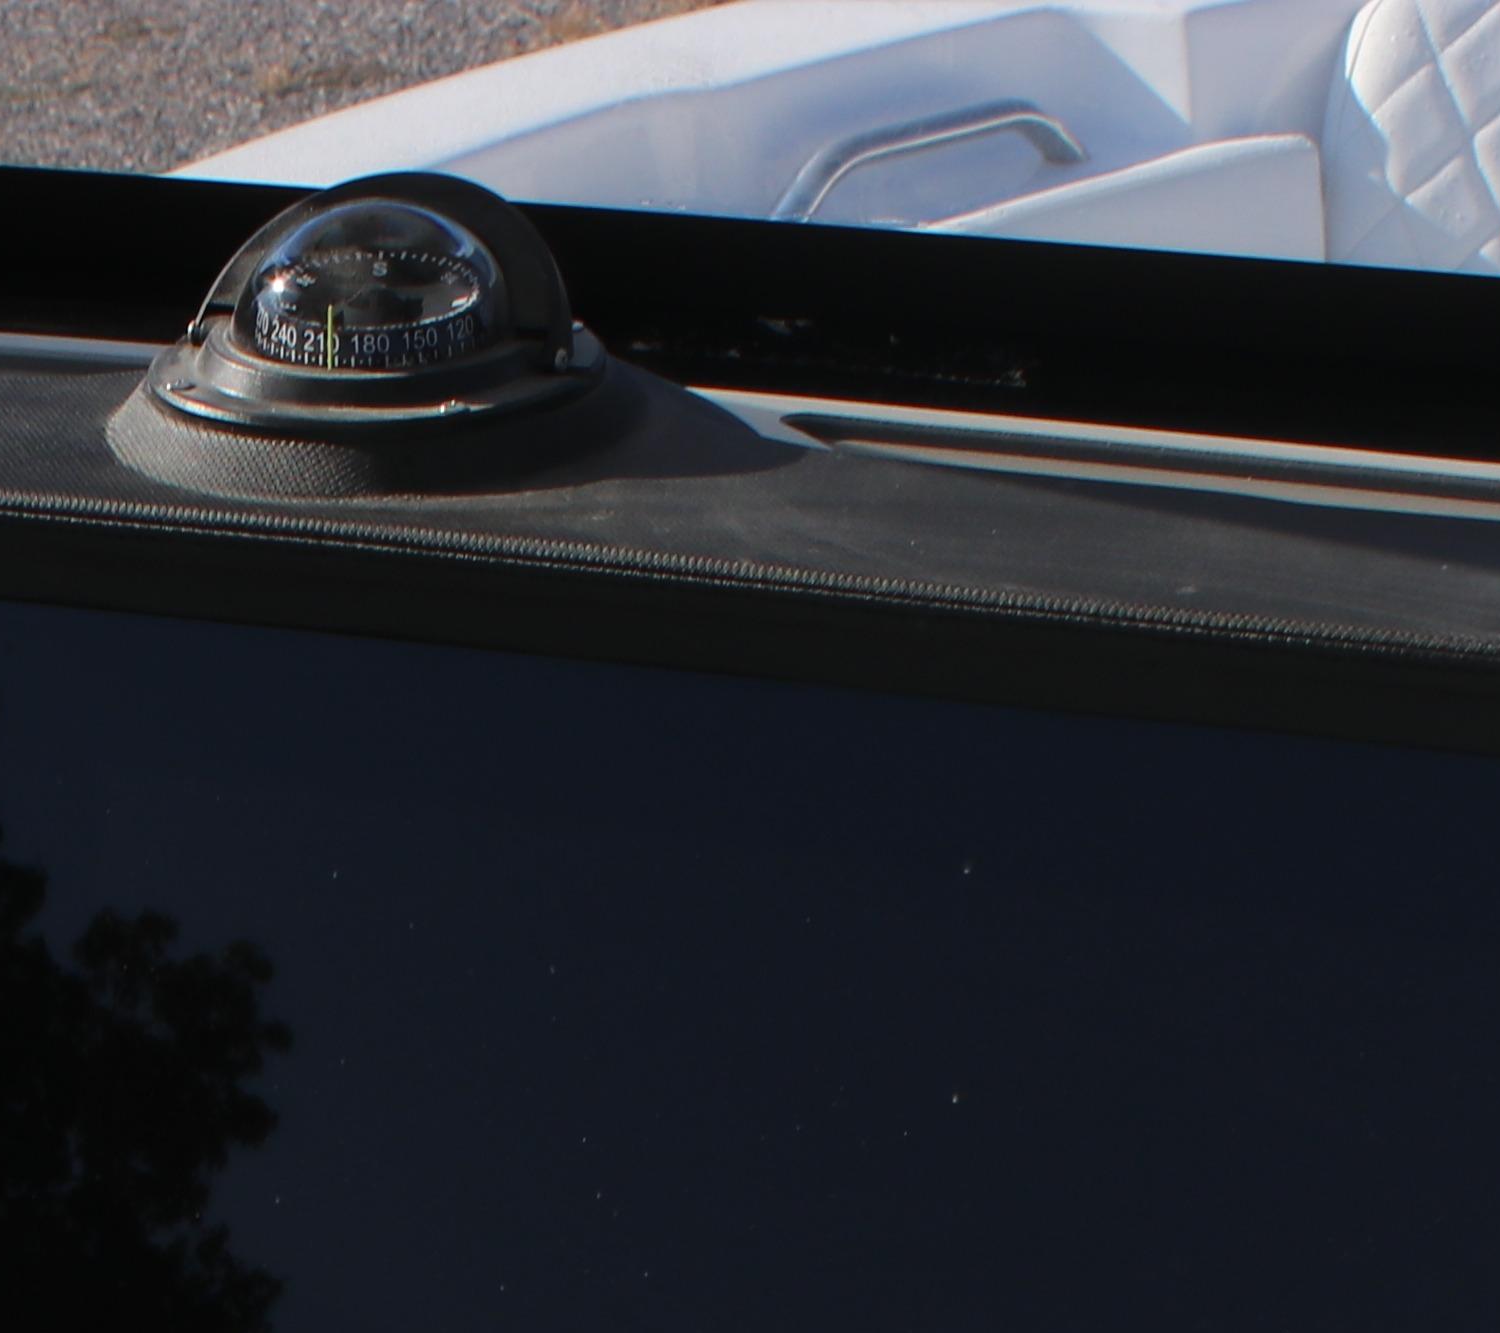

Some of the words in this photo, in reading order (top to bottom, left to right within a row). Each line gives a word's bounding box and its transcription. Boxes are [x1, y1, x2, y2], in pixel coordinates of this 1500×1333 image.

[272, 315, 297, 348] 240
[304, 331, 339, 354] 210
[351, 333, 390, 355] 180
[402, 327, 437, 350] 150
[448, 315, 474, 339] 120
